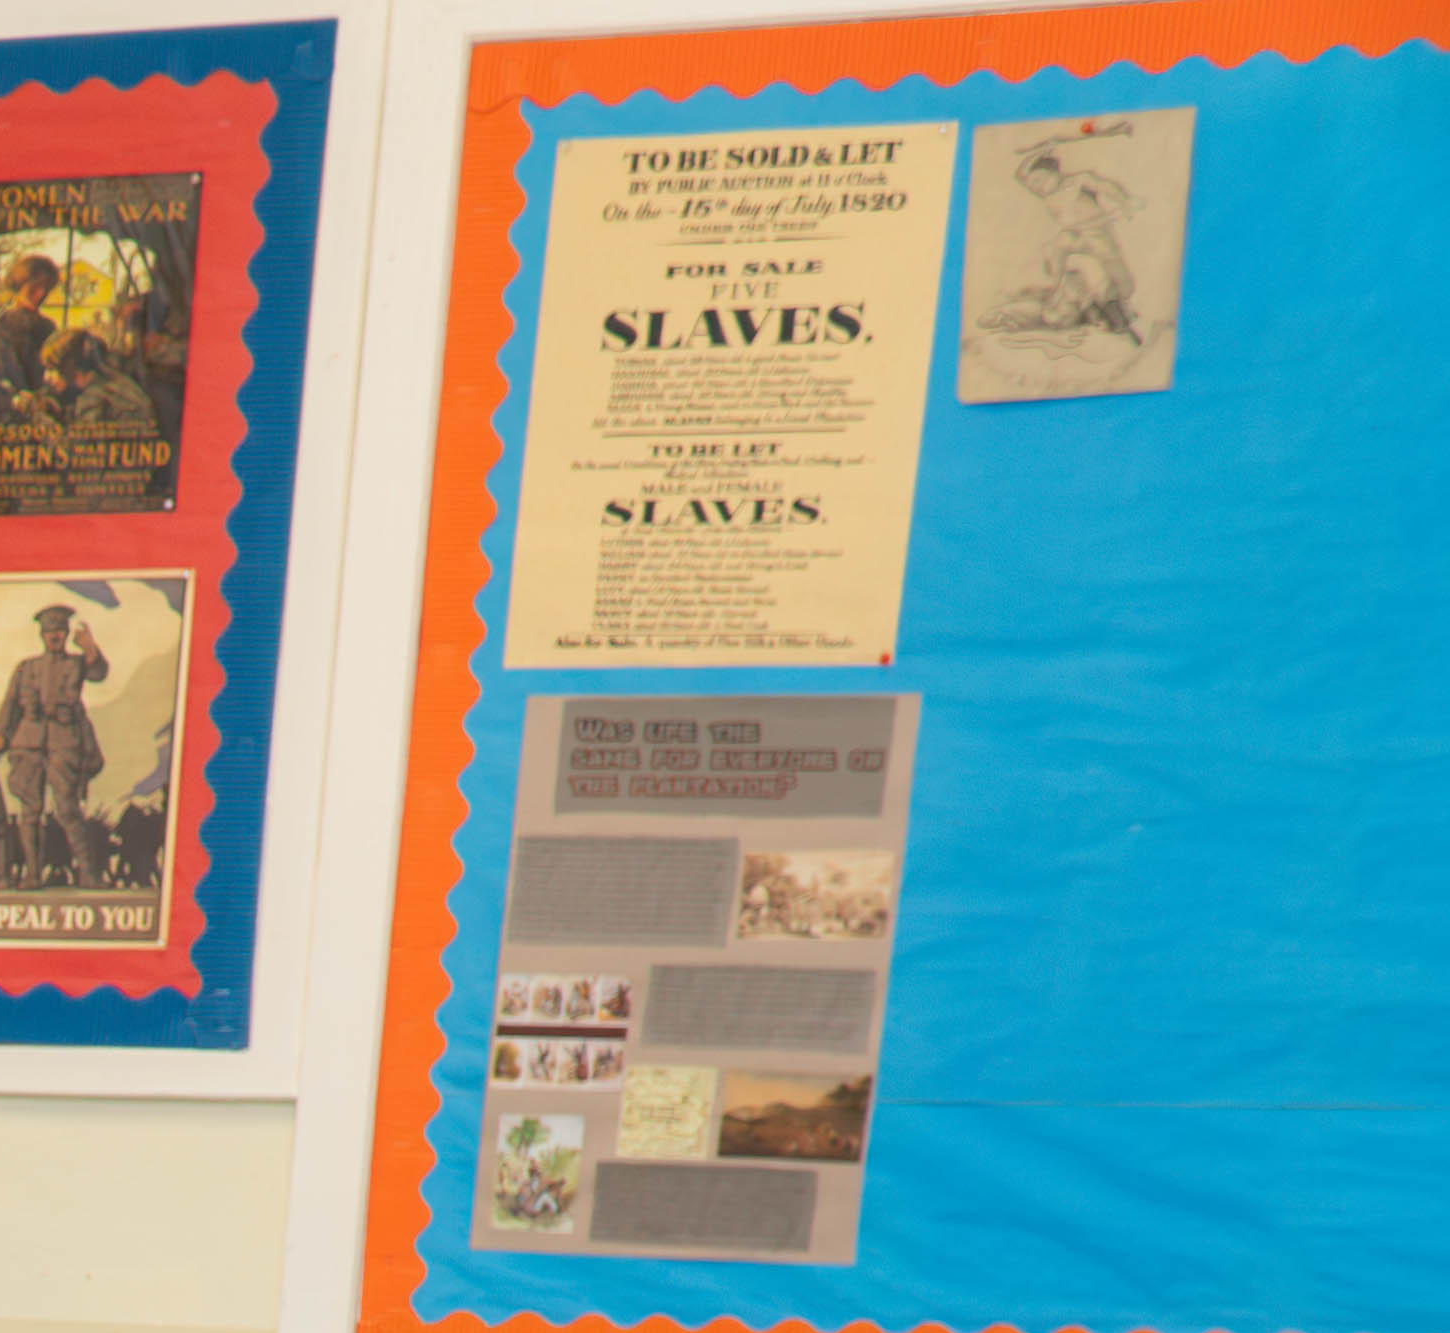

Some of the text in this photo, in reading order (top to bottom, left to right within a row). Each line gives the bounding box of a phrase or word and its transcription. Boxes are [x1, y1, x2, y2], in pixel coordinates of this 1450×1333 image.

[623, 140, 904, 175] TO BE SOLD & LET
[657, 178, 715, 194] PUBLIC
[721, 175, 794, 191] AUCTION
[54, 205, 101, 227] THE
[118, 200, 187, 223] WAR
[602, 203, 629, 221] On
[732, 198, 761, 217] day
[839, 193, 907, 212] 1820
[666, 259, 826, 279] FOR SALE
[711, 281, 780, 301] FIVE
[600, 302, 873, 352] SLAVES.
[108, 442, 172, 467] FUND
[648, 442, 783, 458] TO BE LET
[600, 496, 828, 528] SLAVES.
[60, 905, 94, 930] TO
[100, 905, 153, 931] YOU
